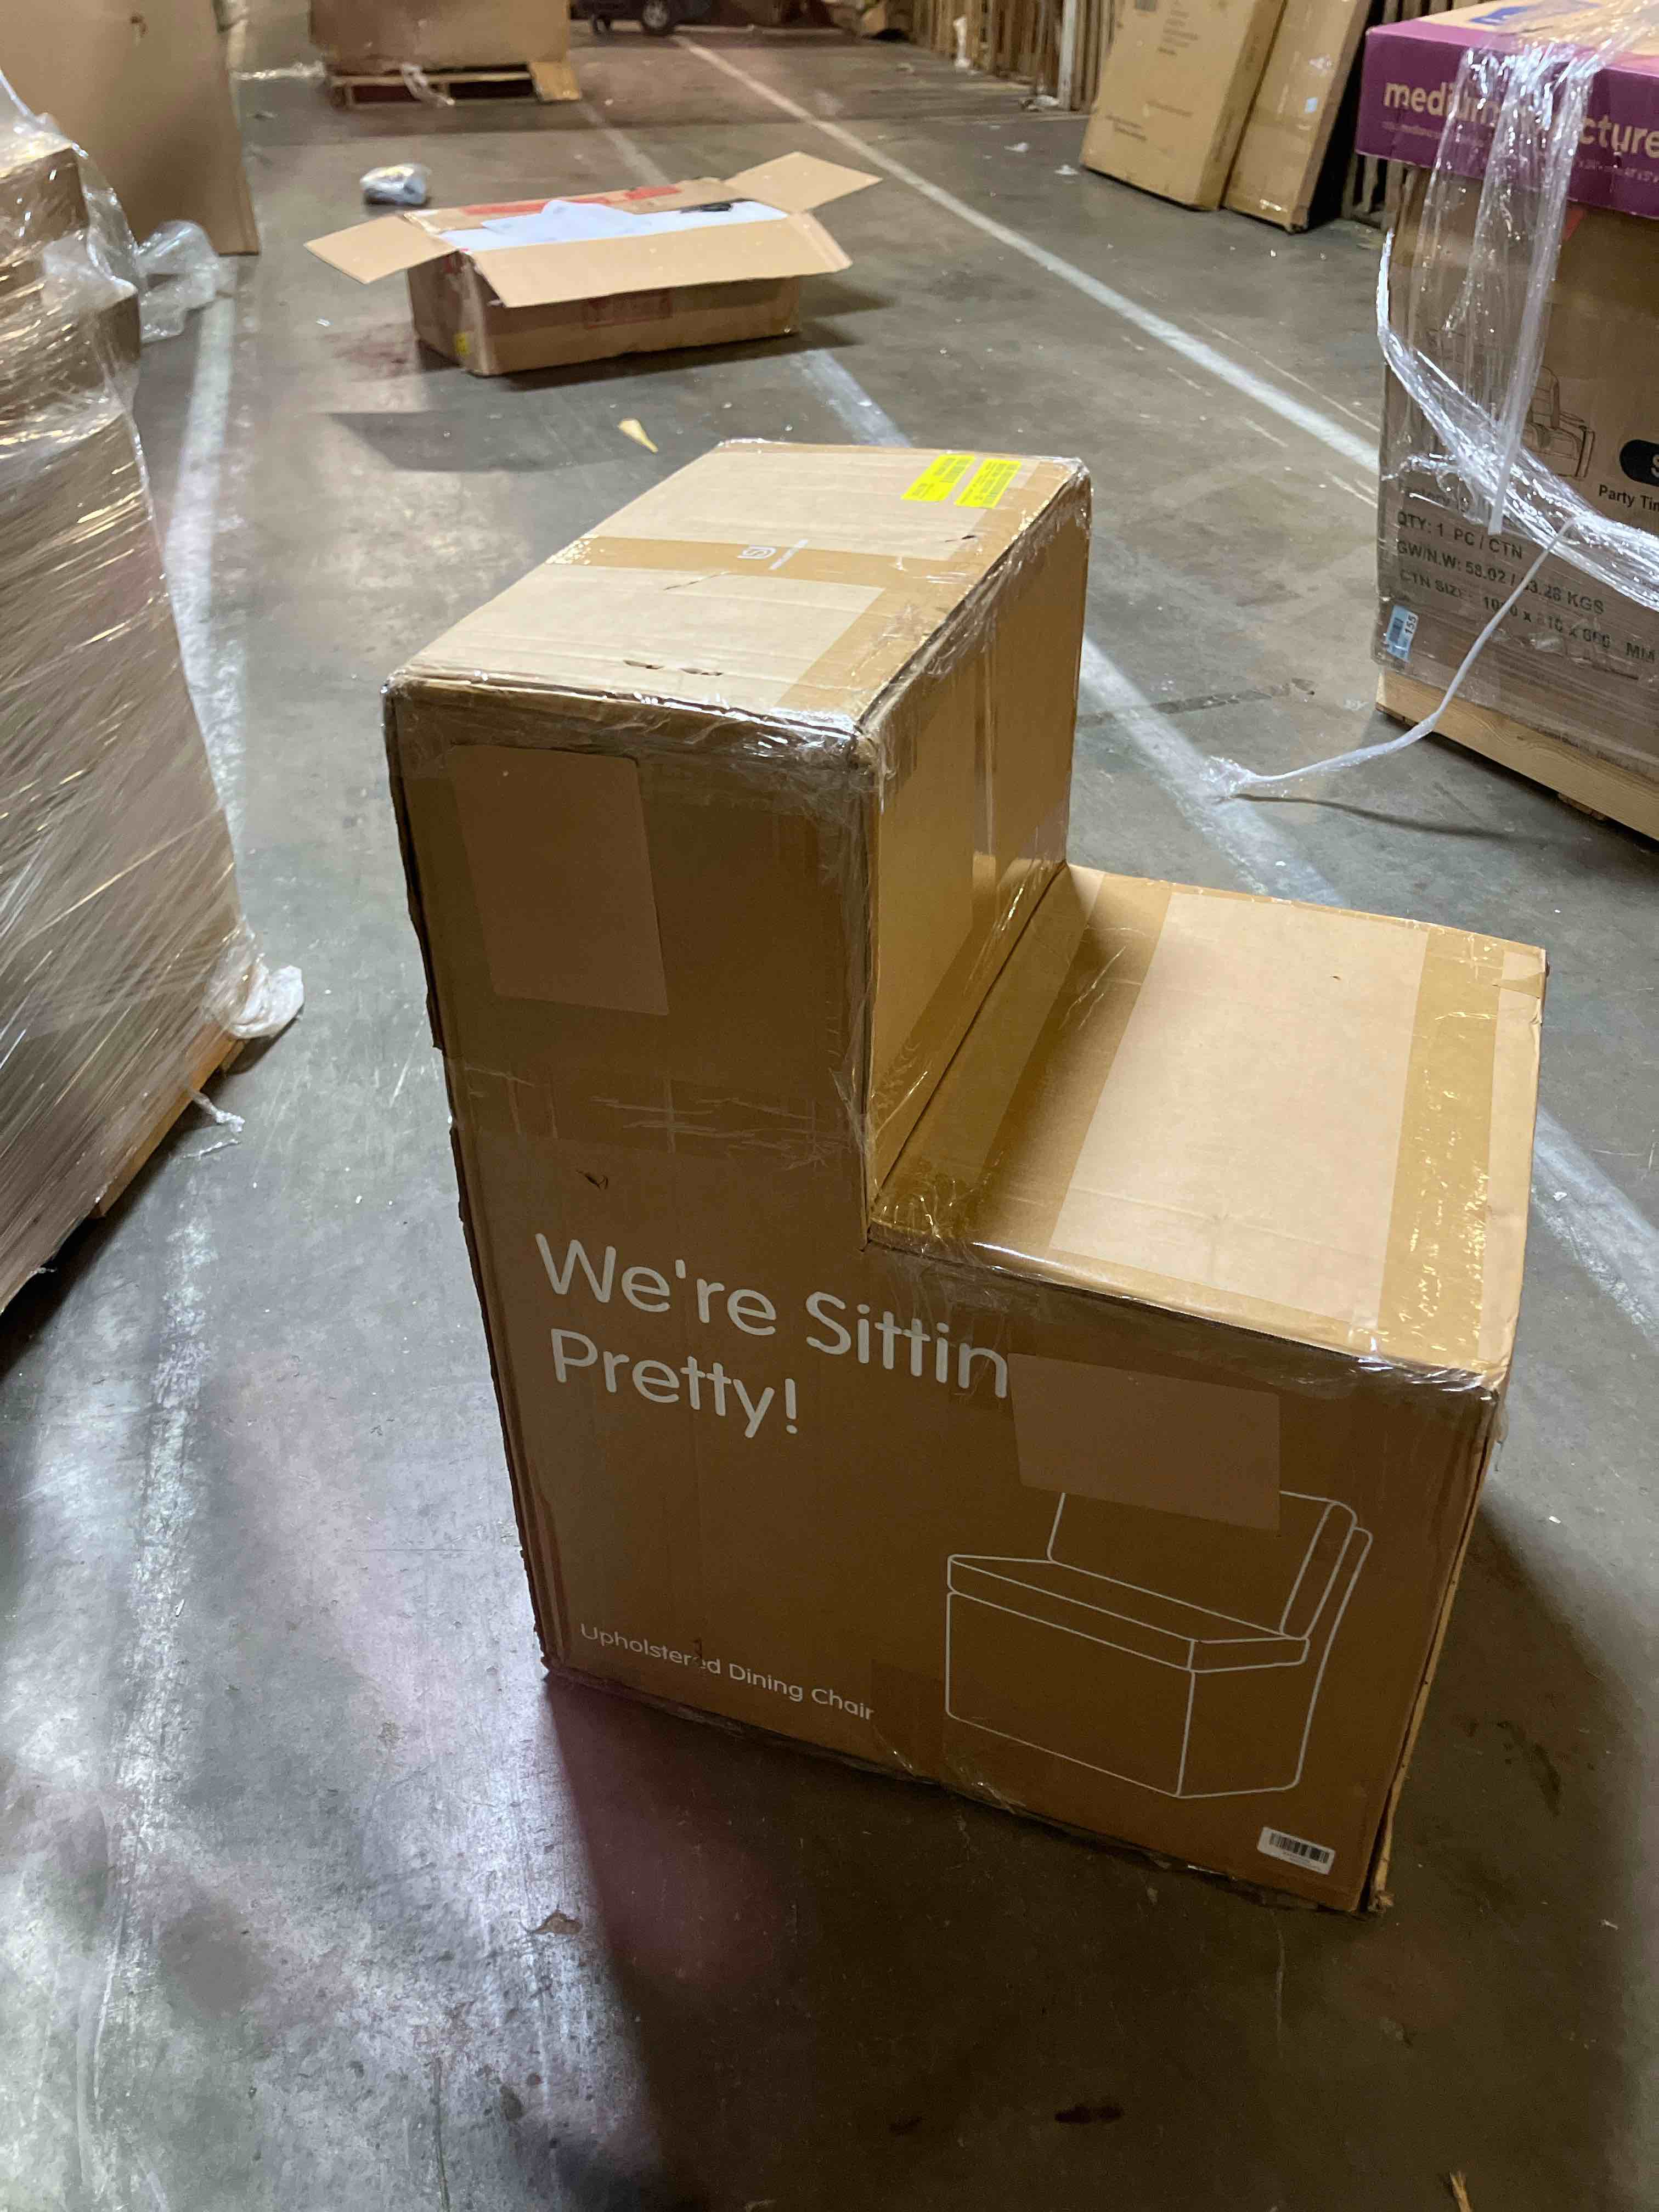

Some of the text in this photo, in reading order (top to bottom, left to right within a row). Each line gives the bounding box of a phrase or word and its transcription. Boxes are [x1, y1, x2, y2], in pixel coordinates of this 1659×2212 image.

[1599, 484, 1635, 508] Party
[1397, 510, 1431, 534] QTY:
[1437, 523, 1443, 537] 1
[1454, 528, 1475, 546] PC
[1488, 538, 1522, 560] CTN
[1400, 569, 1431, 589] CTN
[1567, 591, 1605, 615] KGS
[535, 1232, 777, 1336] We're
[550, 1328, 798, 1438] Pretty!
[729, 1663, 803, 1702] Dining
[811, 1688, 874, 1720] Chair
